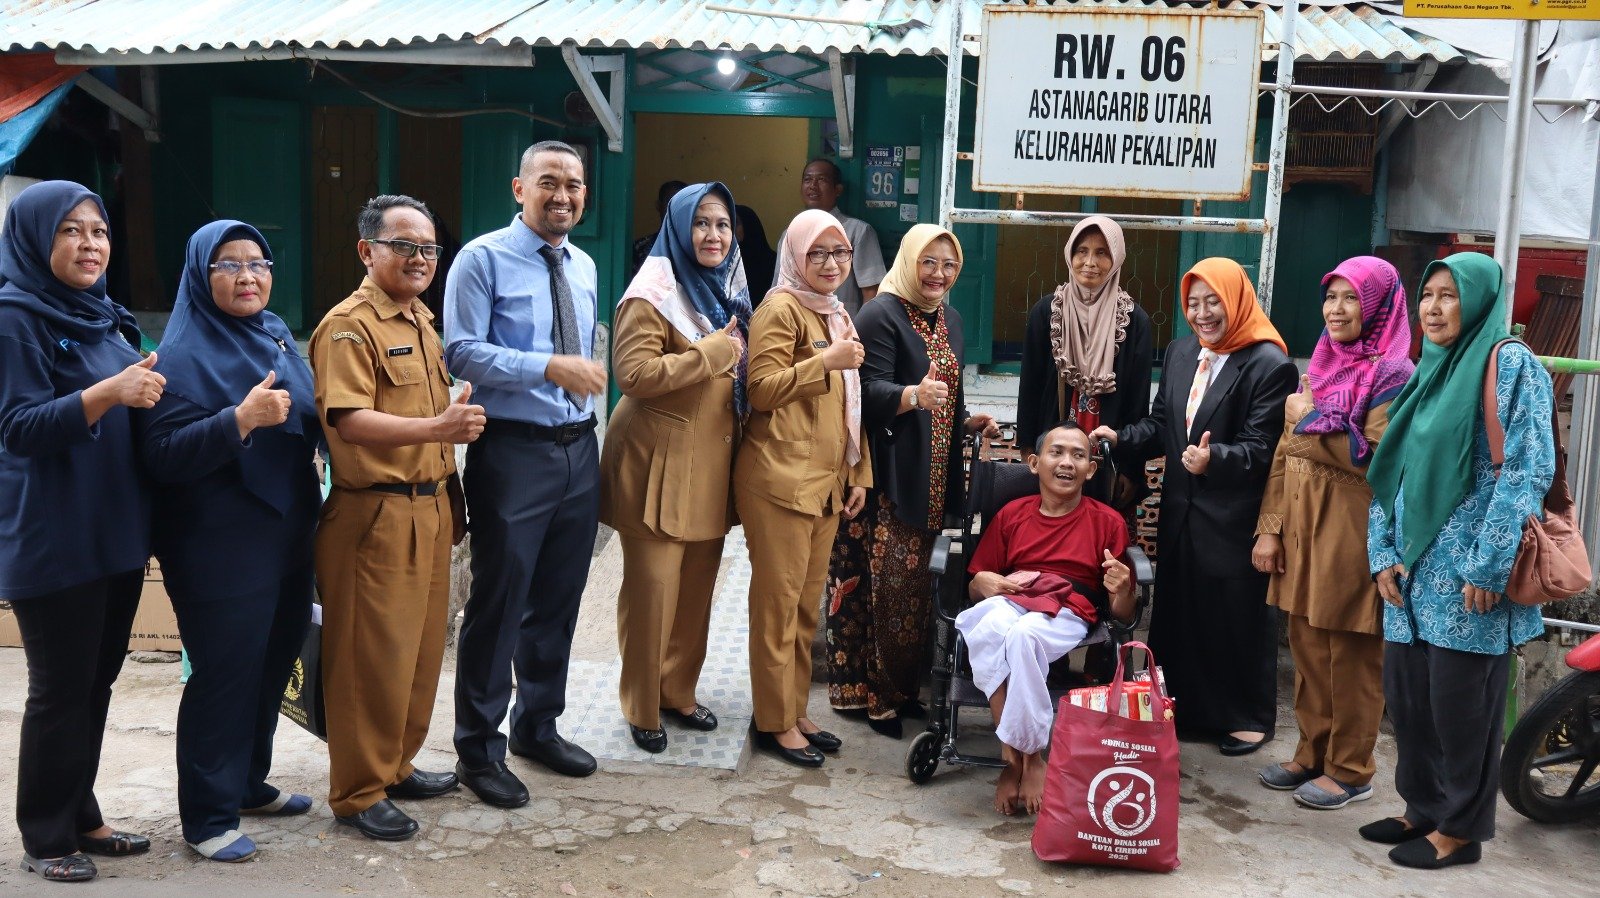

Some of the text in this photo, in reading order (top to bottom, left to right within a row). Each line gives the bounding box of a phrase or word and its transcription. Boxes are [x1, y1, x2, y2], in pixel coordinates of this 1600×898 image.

[1053, 33, 1186, 82] RW. 06
[1028, 88, 1212, 124] ASTANAGARIB UTARA
[1013, 129, 1217, 168] KELURAHAN PEKALIPAN
[871, 171, 894, 195] 96
[1101, 739, 1157, 753] #DINAS SOSIAL
[1113, 750, 1140, 761] Hadir
[1077, 831, 1160, 847] BANTUAN DINAS SOSIAL
[1092, 843, 1148, 855] KOTA CIREBON
